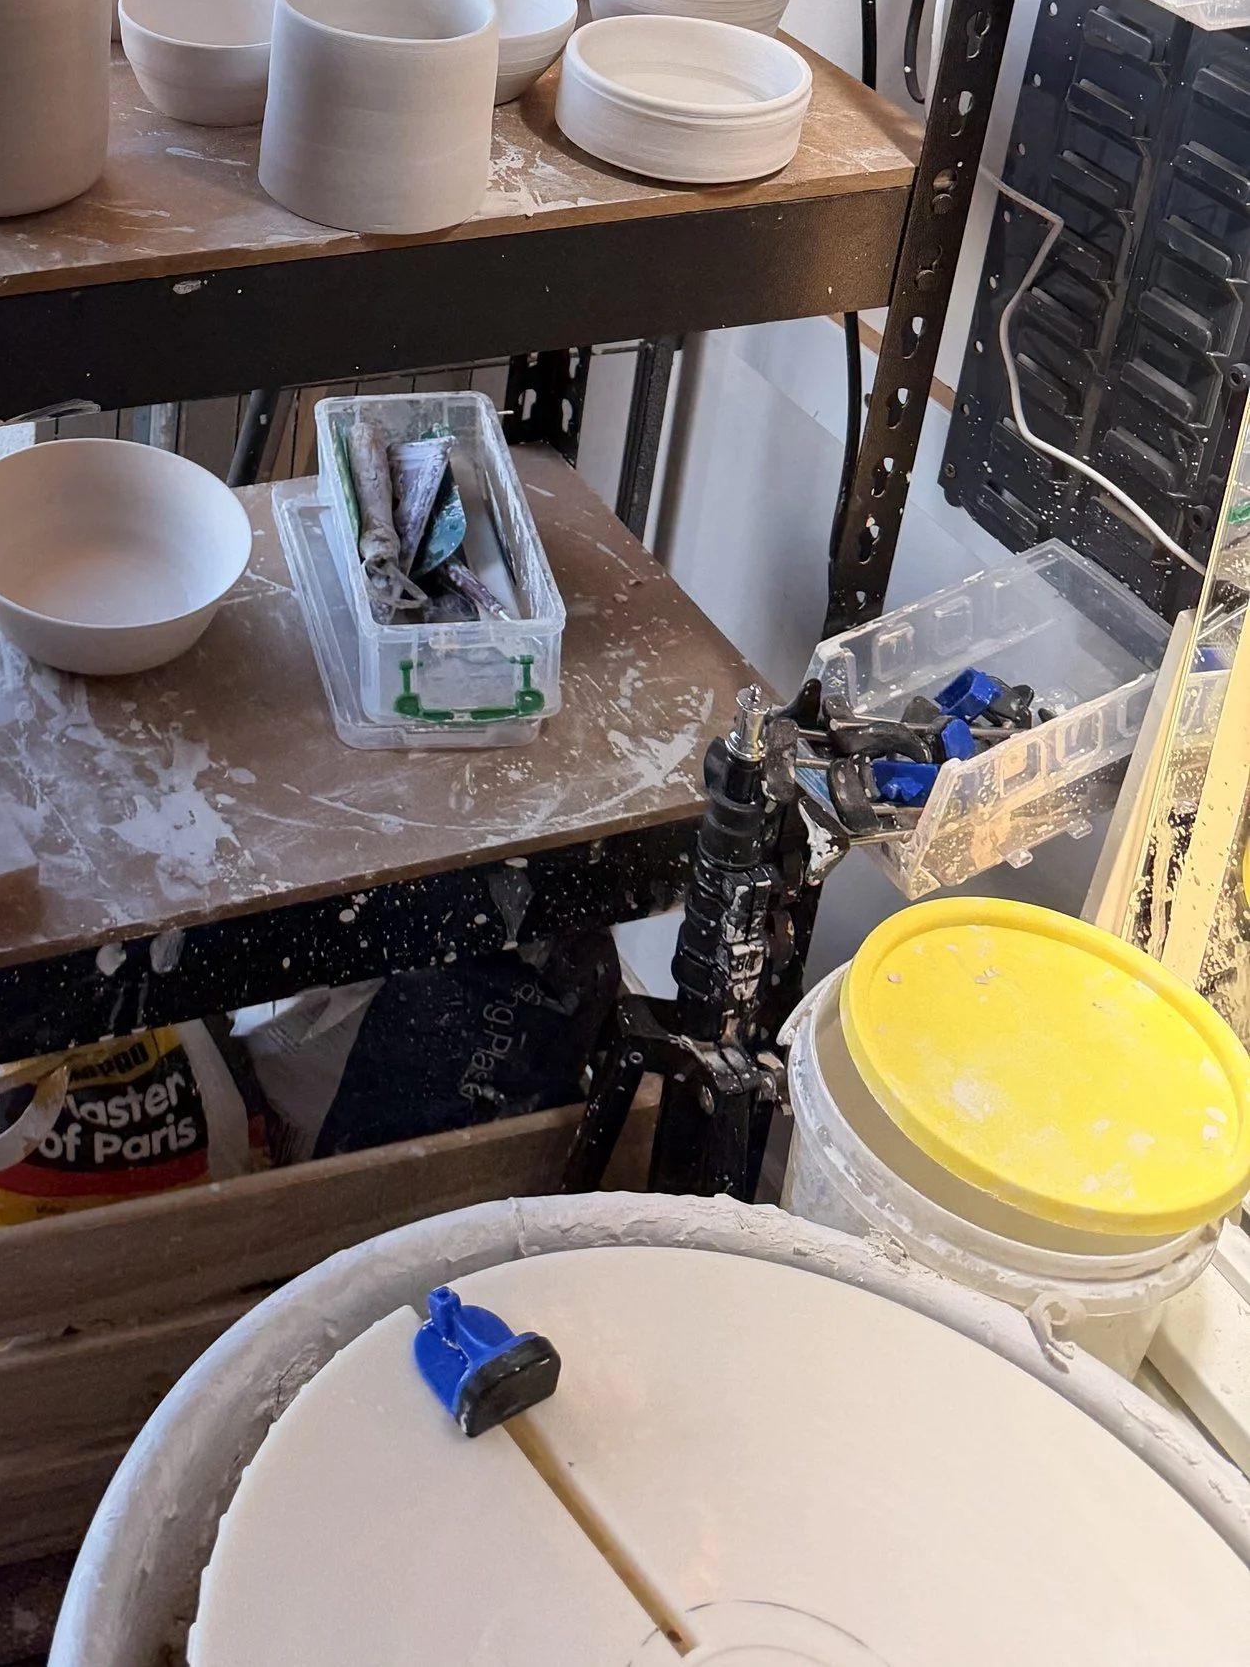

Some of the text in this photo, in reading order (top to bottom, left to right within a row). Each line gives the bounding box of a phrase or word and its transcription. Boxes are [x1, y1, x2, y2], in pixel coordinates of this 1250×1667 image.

[65, 1071, 186, 1128] laster
[38, 1113, 197, 1164] of Paris
